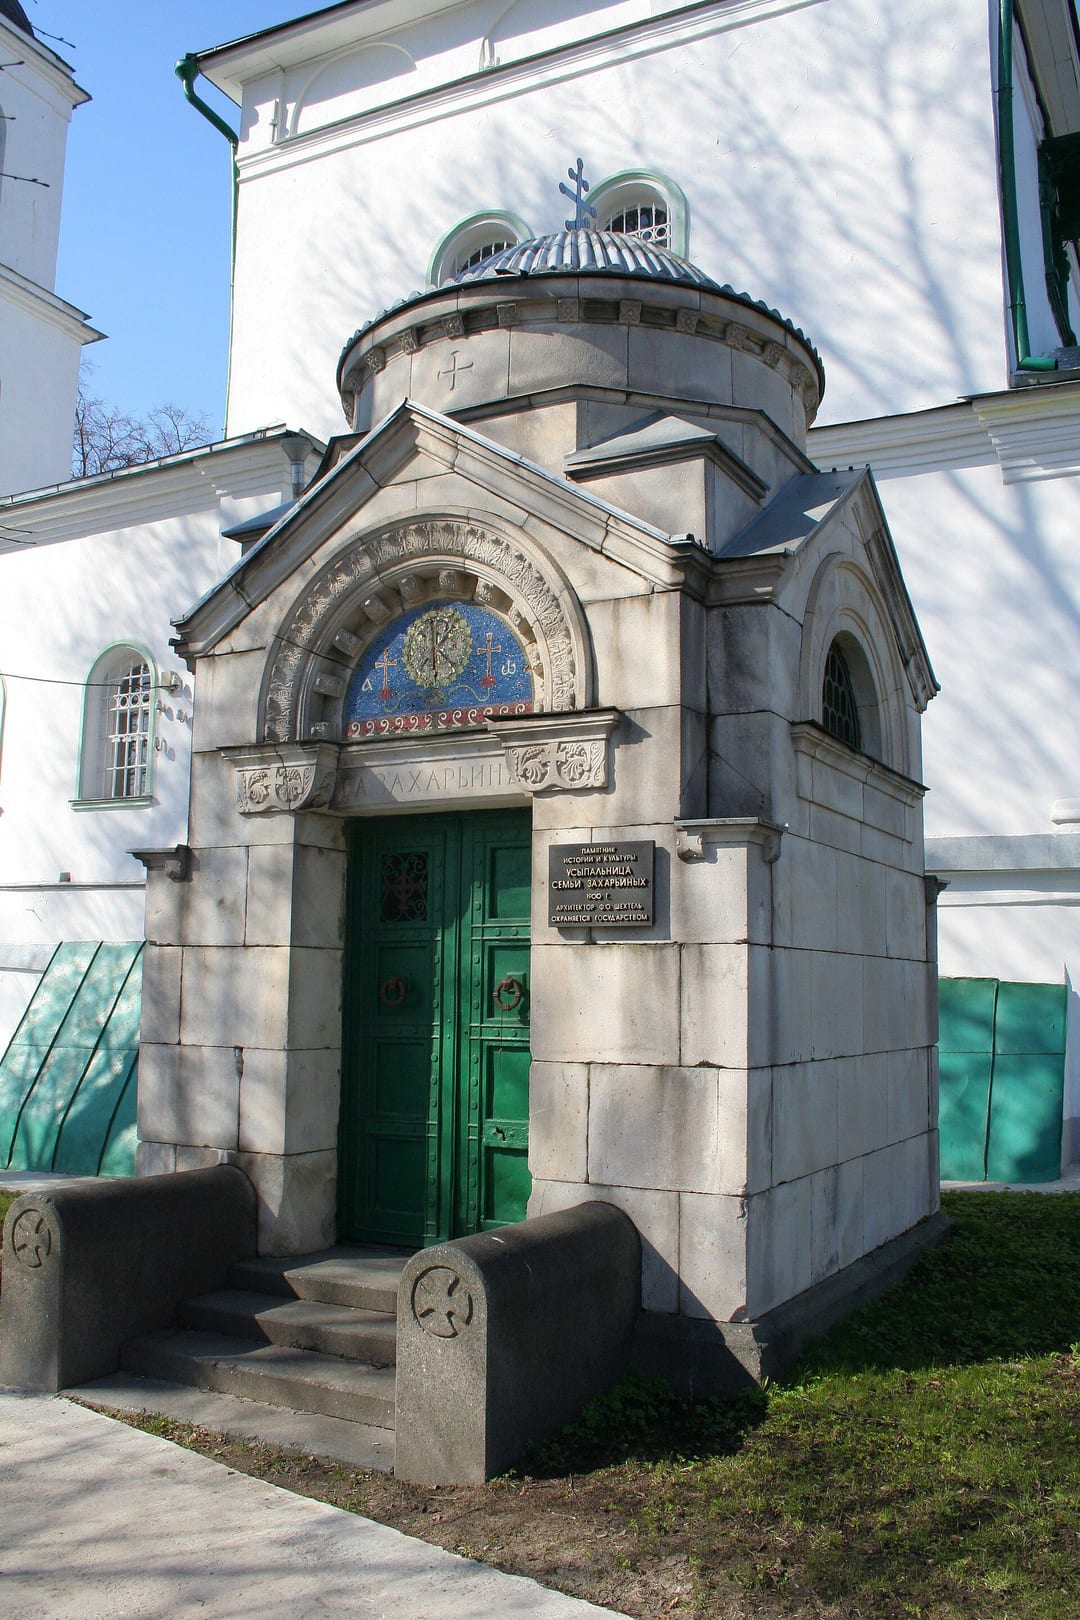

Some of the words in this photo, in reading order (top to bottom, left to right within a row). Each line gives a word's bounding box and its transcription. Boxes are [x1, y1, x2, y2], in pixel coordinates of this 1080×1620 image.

[563, 856, 594, 864] ИСТОРИИ
[596, 855, 601, 863] И
[603, 854, 636, 863] КУЛЬТУРЫ
[566, 866, 632, 877] УСЫПАЛЬНИЦА
[551, 880, 581, 889] СЕМЬИ
[587, 878, 646, 888] ЗАХАРЬИНЫХ
[556, 903, 595, 911] АРХИТЕКТОР
[614, 902, 642, 910] ШЕХТЕЛЬ
